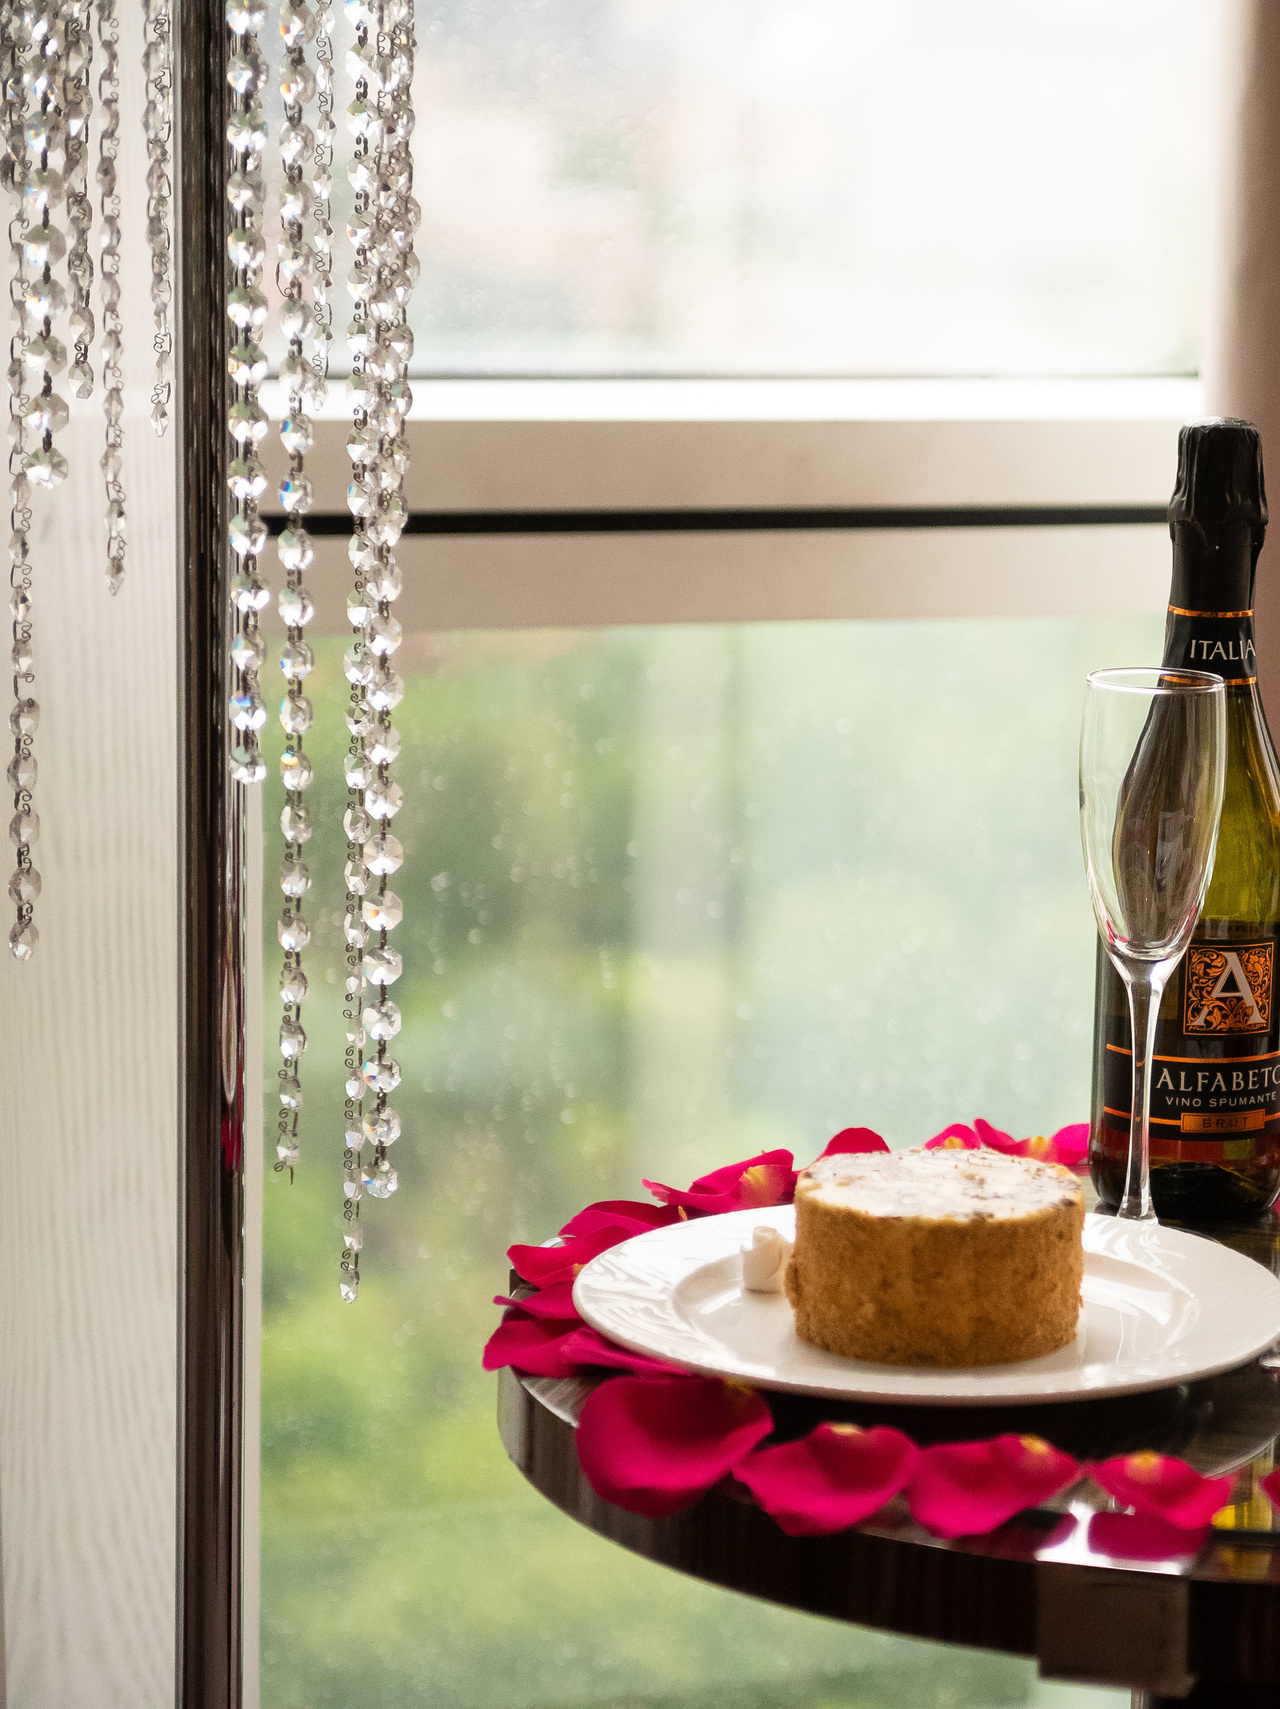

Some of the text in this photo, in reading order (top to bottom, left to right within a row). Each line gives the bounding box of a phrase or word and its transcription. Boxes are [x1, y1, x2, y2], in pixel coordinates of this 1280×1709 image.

[1190, 639, 1256, 660] ITALIA
[1190, 951, 1268, 1026] A
[1165, 1091, 1277, 1108] VINO SPUMANTE
[1202, 1117, 1249, 1128] BRUT
